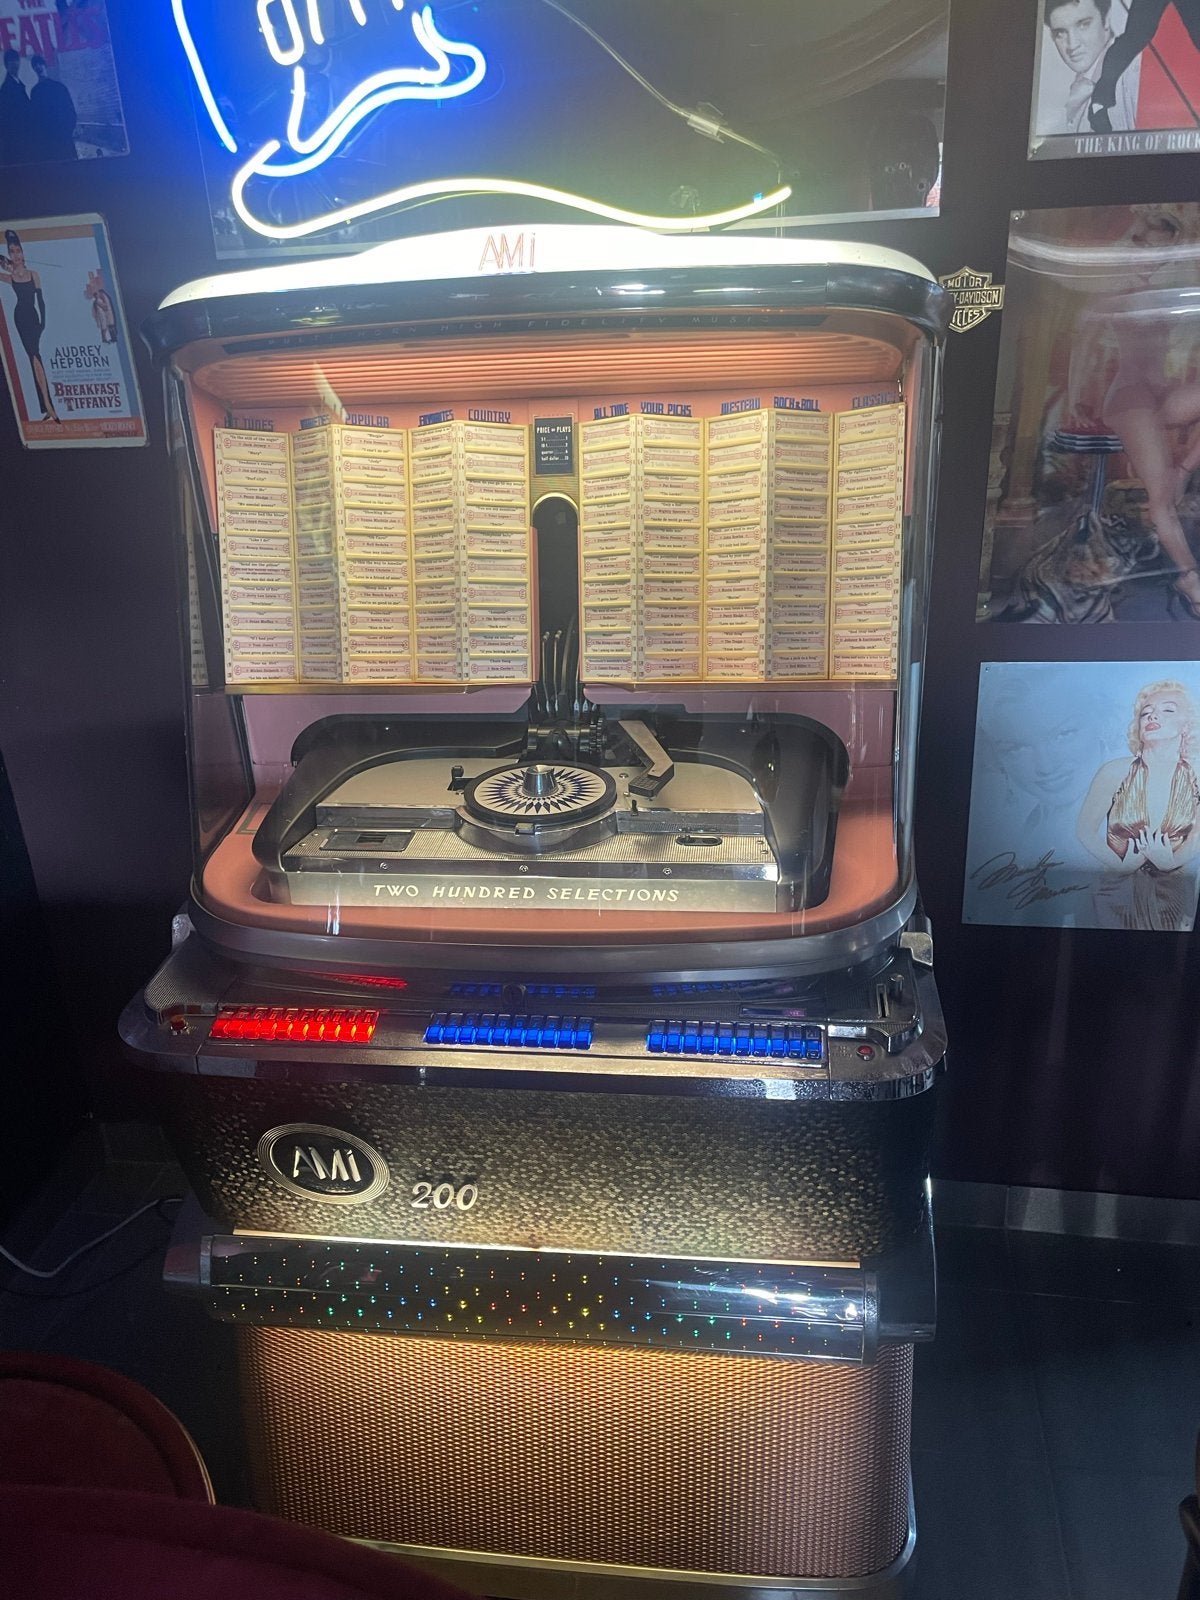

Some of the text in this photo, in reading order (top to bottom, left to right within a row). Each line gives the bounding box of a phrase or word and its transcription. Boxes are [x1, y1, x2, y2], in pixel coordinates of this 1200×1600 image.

[0, 5, 108, 67] EATLES
[1075, 137, 1103, 153] THE
[1107, 135, 1140, 152] KING
[1145, 134, 1162, 150] OF
[947, 275, 982, 288] MOTOR
[55, 345, 101, 358] AUDREY
[50, 356, 110, 369] HEPBURN
[51, 382, 120, 396] BREAKFAST
[63, 394, 122, 411] TIFFANY'S
[640, 402, 692, 417] YOUR PICKS
[468, 408, 511, 424] COUNTRY
[593, 402, 629, 420] ALL TIME
[345, 412, 389, 428] POPULAR
[373, 884, 680, 902] TWO HUNDRED SELECTIONS
[410, 1181, 478, 1211] 200
